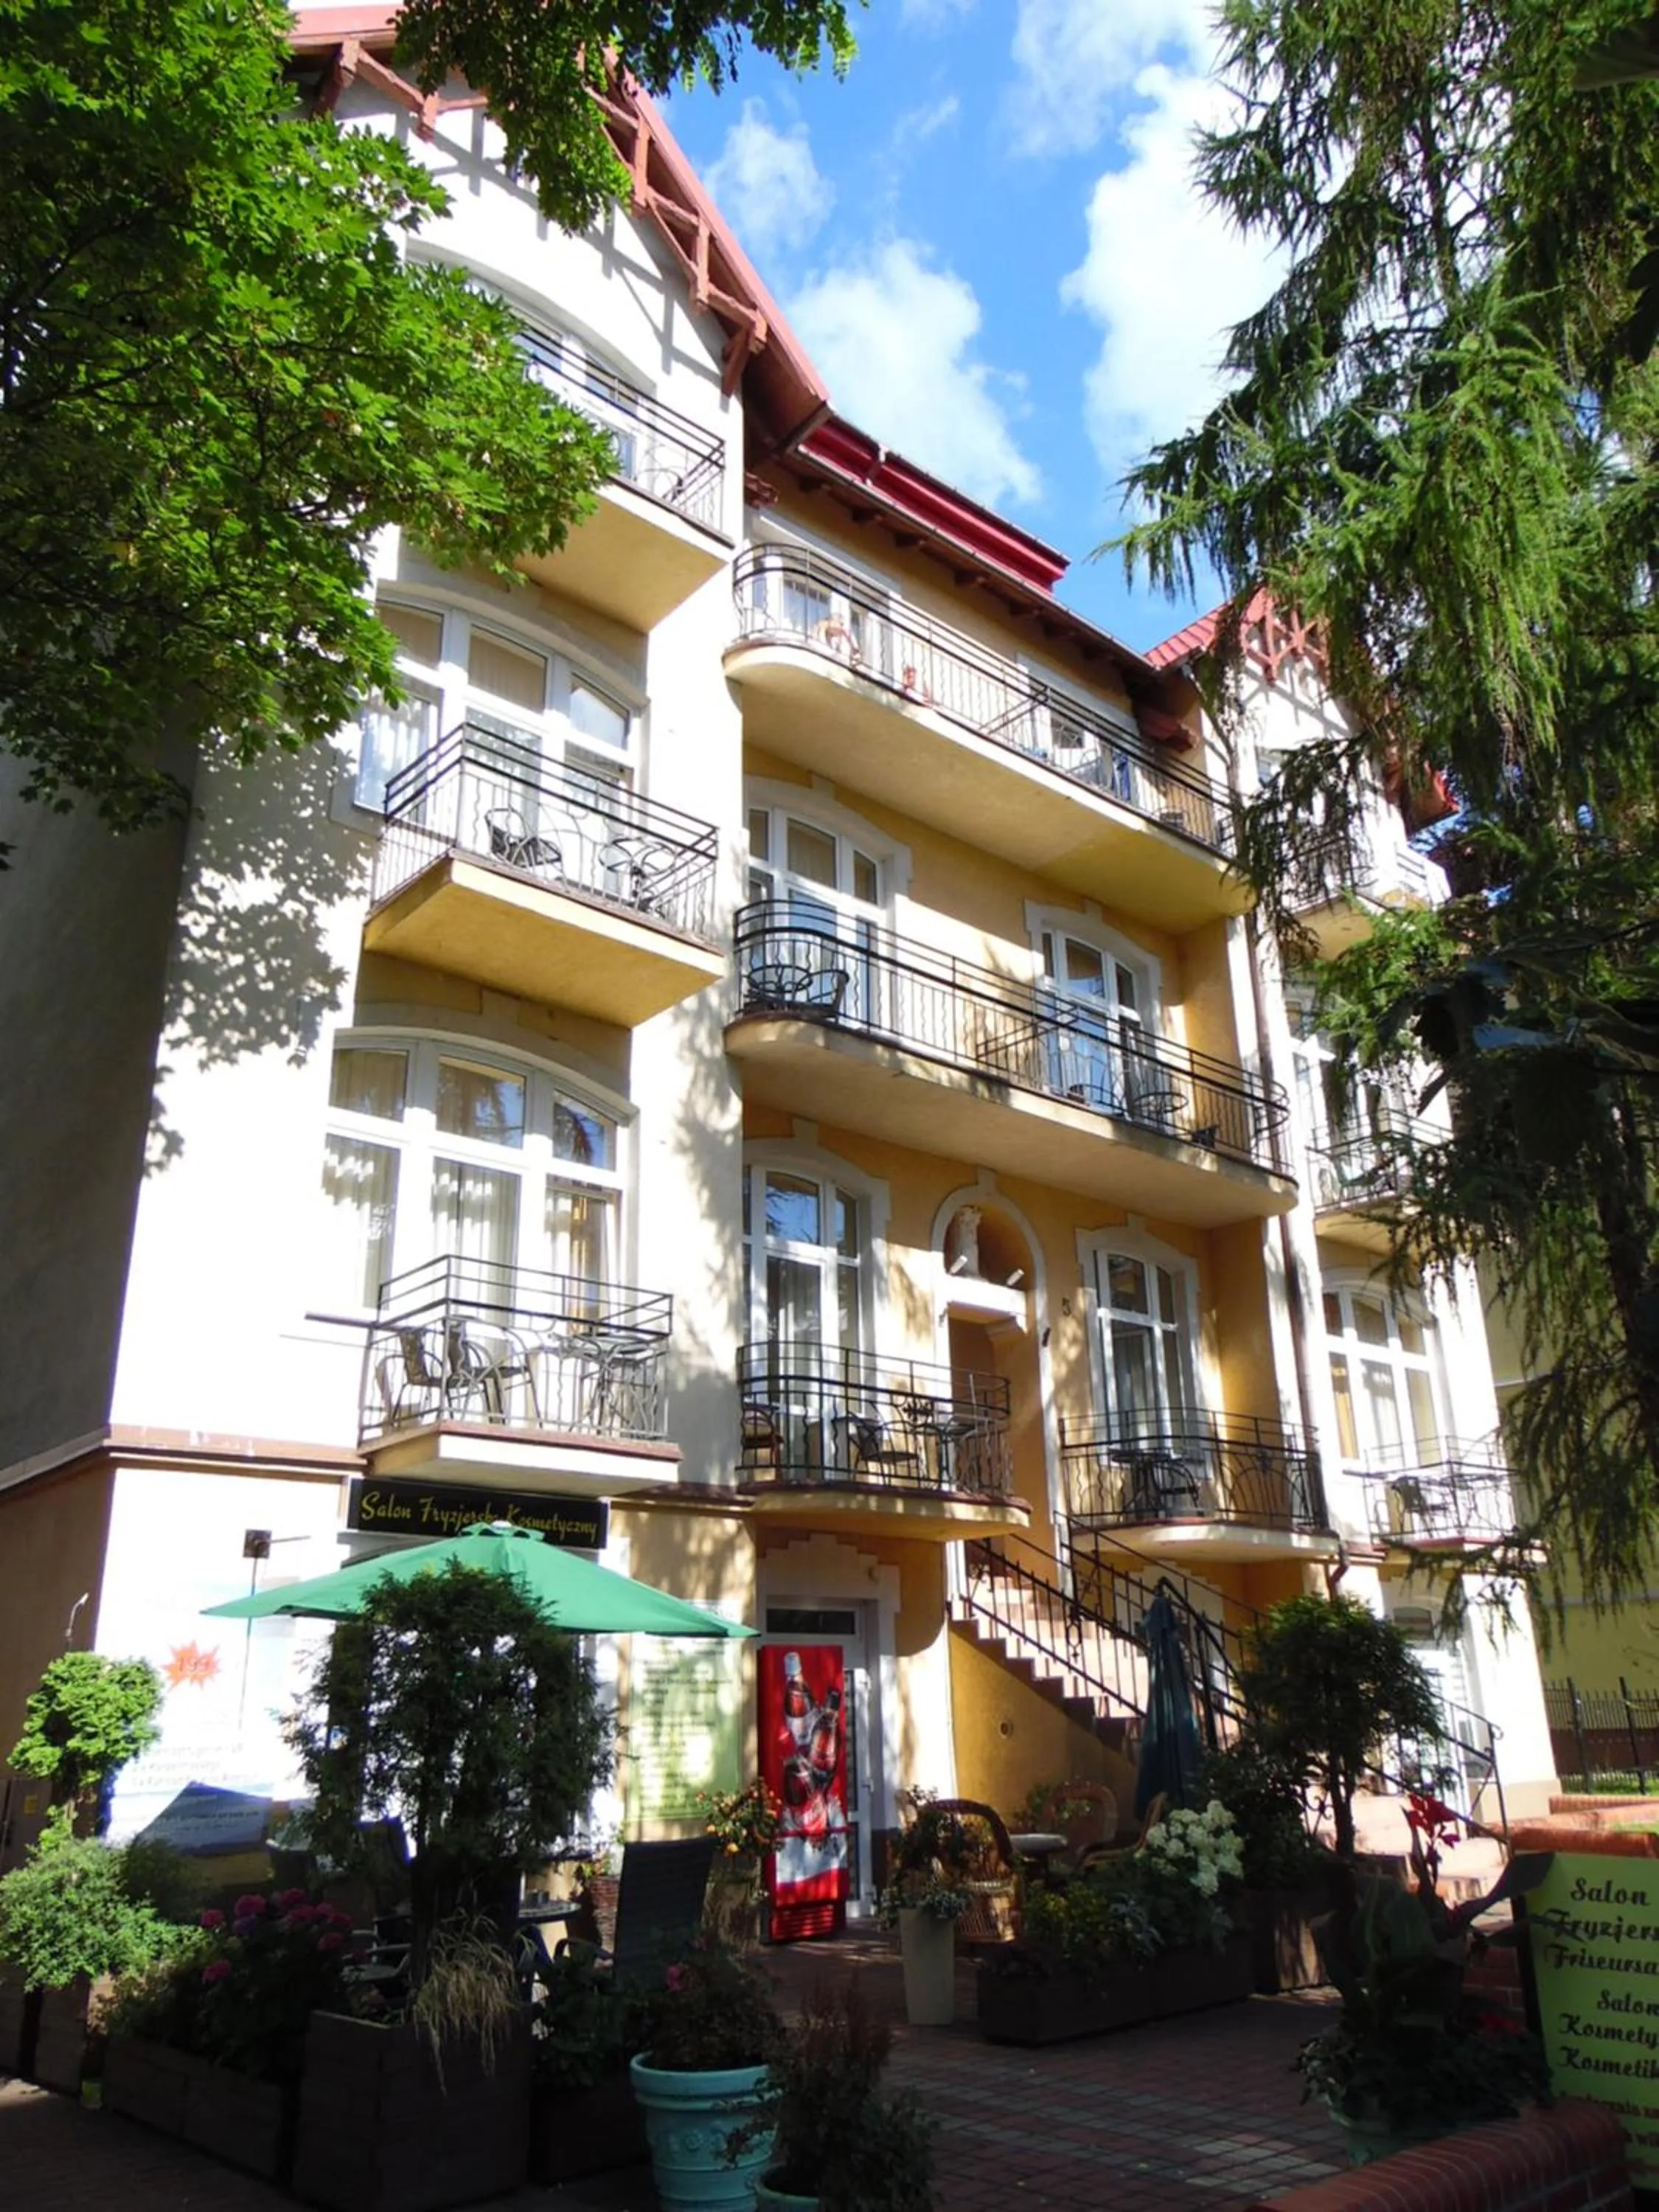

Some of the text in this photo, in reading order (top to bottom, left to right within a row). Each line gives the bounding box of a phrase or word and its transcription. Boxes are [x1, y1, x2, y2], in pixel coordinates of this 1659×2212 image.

[361, 1491, 411, 1521] Salon
[1570, 1877, 1652, 1906] Salon
[1596, 1989, 1659, 2017] Salon
